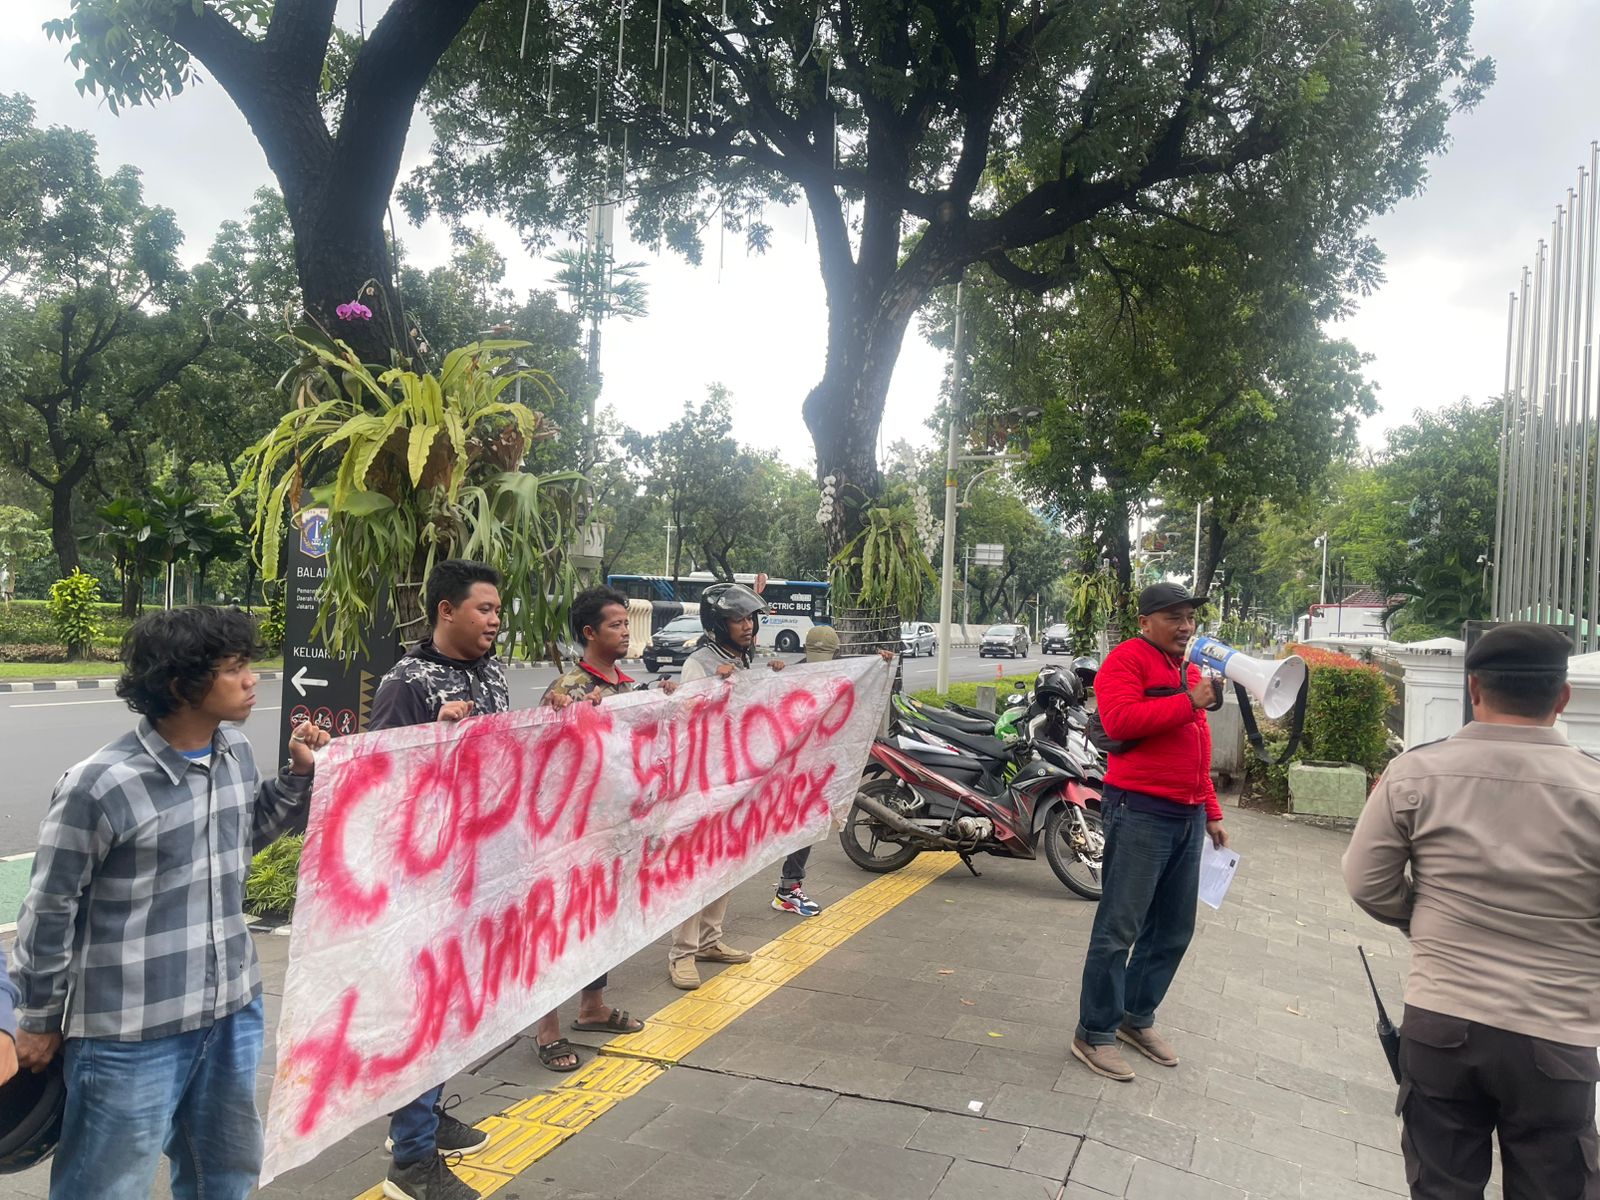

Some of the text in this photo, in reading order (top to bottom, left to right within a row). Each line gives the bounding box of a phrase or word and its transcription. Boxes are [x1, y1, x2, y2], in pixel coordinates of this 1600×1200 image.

[296, 566, 326, 578] BALAI
[796, 603, 812, 611] BUS
[293, 646, 331, 660] KELUAR
[317, 703, 613, 920] COPOT
